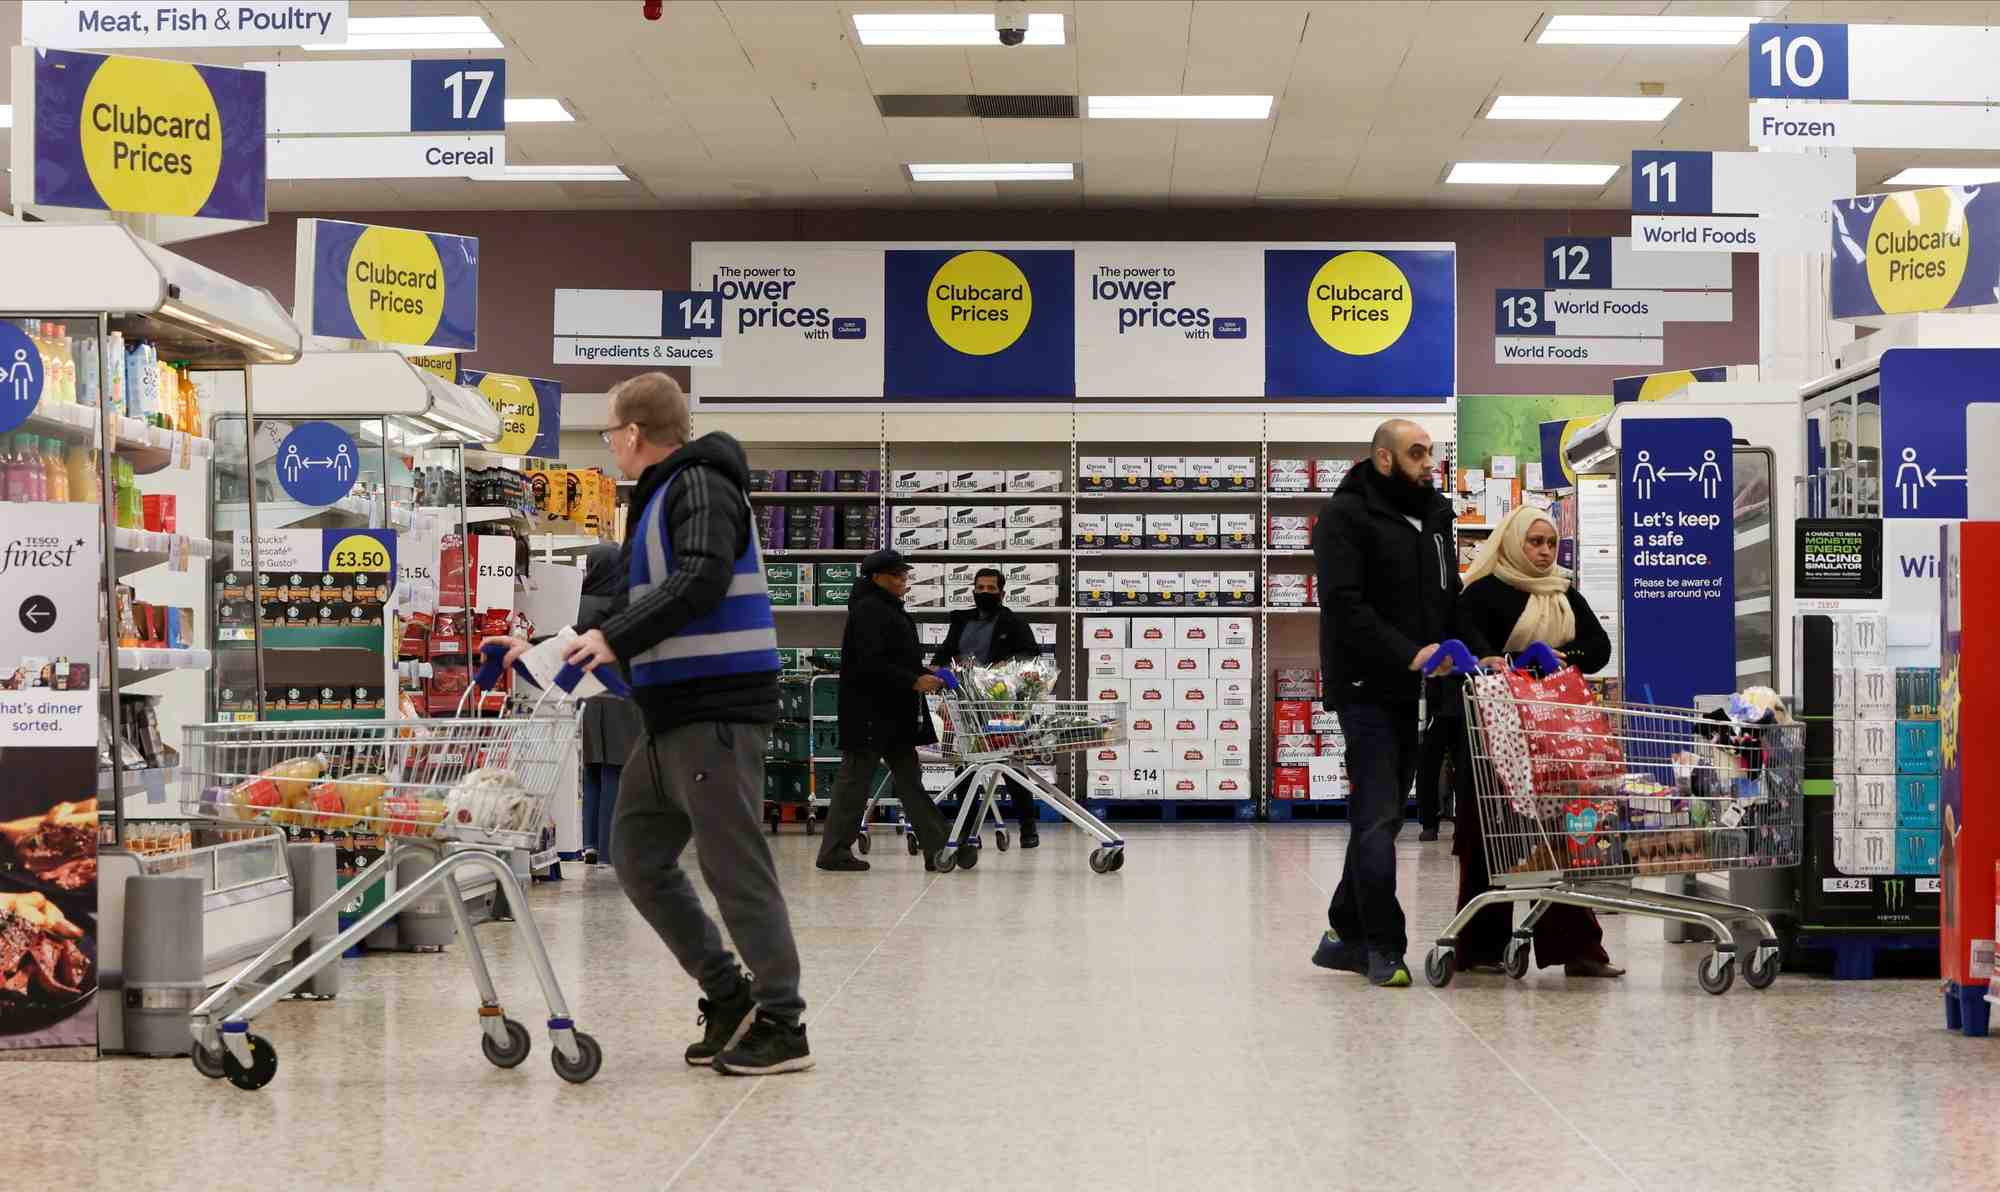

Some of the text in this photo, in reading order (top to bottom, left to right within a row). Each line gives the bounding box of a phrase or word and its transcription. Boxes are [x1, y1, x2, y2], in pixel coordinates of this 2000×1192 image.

[78, 6, 332, 36] Meat, Fish & Poultry
[1761, 36, 1824, 88] 10
[443, 71, 494, 119] 17
[92, 103, 211, 141] Clubcard
[1762, 117, 1835, 137] Frozen
[112, 140, 192, 176] Prices
[425, 146, 493, 167] Cereal
[1641, 161, 1677, 202] 11
[1643, 226, 1756, 245] World Foods
[1875, 230, 1961, 256] Clubcard
[1552, 245, 1591, 281] 12
[1889, 259, 1946, 282] Prices
[355, 261, 437, 289] Clubcard
[719, 266, 796, 280] The power to
[1099, 266, 1176, 280] The power to
[712, 274, 796, 301] lower
[935, 285, 1023, 301] Clubcard
[1092, 274, 1176, 301] lower
[1316, 285, 1403, 301] Clubcard
[369, 290, 423, 315] Prices
[1554, 299, 1648, 315] World Foods
[679, 299, 715, 330] 14
[738, 302, 831, 334] prices
[951, 306, 1009, 322] Prices
[1119, 302, 1210, 334] prices
[1331, 306, 1389, 322] Prices
[1502, 296, 1537, 328] 13
[804, 328, 829, 340] with
[1185, 328, 1210, 340] with
[574, 344, 713, 361] Ingredients & Sauces
[1504, 345, 1588, 360] World Foods
[1633, 511, 1721, 530] Let's keep
[25, 537, 59, 545] TESCO
[1634, 531, 1684, 547] a safe
[1805, 545, 1861, 553] ENERGY
[0, 540, 76, 575] finest
[336, 551, 384, 567] £3.50
[1633, 550, 1712, 566] distance.
[1805, 554, 1862, 562] RACING
[480, 565, 514, 577] £1.50
[1900, 555, 1941, 578] Wi
[1633, 577, 1723, 588] Please be aware of
[1633, 589, 1721, 599] others around you
[0, 702, 83, 714] hat's dinner
[12, 719, 63, 731] sorted.
[1133, 769, 1158, 782] £14
[1312, 775, 1338, 783] £11.99
[1836, 880, 1867, 889] £4.25
[1928, 880, 1941, 889] £4
